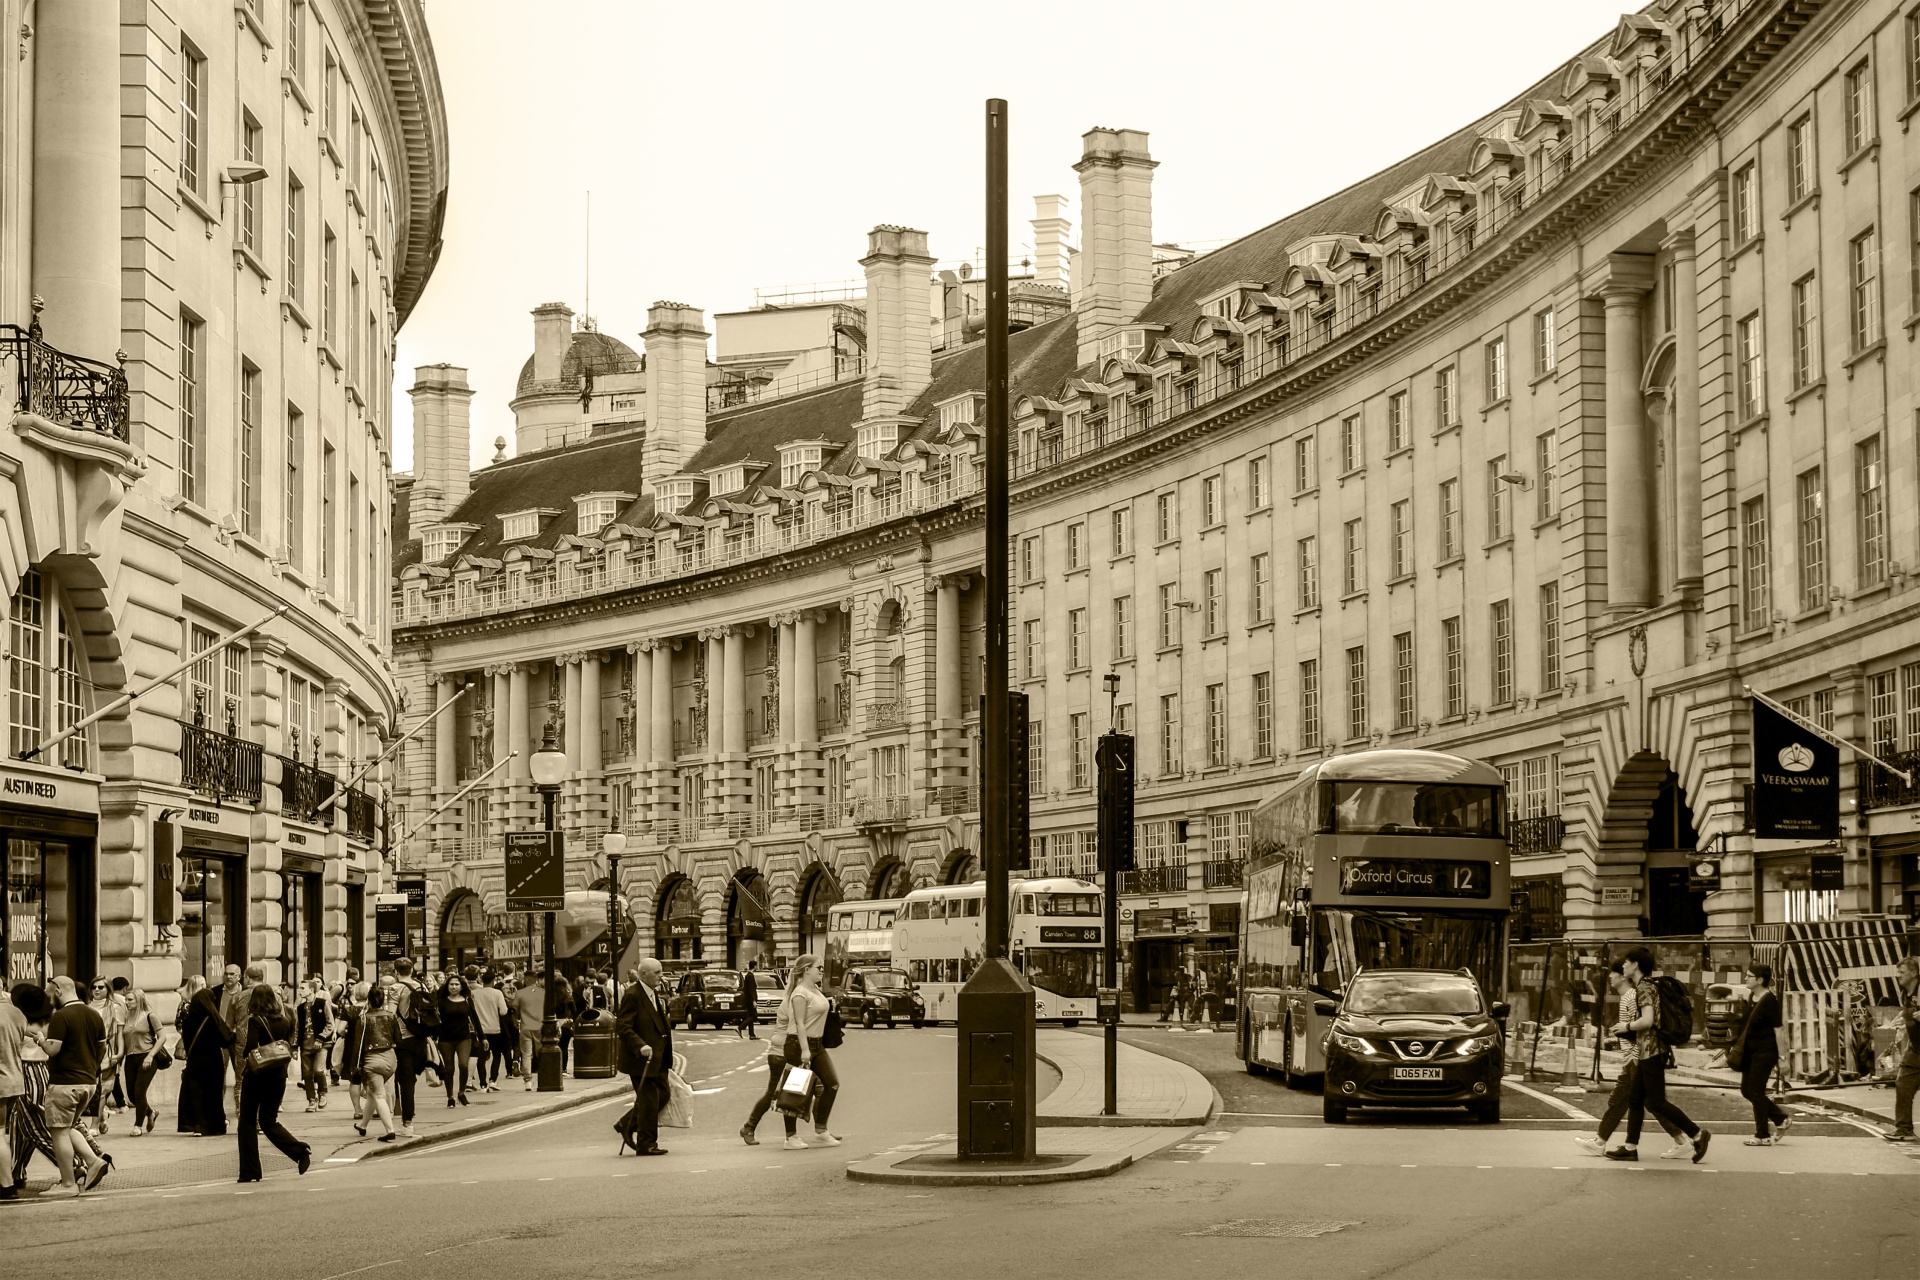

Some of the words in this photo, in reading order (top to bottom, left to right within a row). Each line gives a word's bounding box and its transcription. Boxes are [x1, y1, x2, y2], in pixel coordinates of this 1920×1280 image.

[1761, 774, 1830, 786] VEERASWAMY
[3, 777, 34, 795] AUSTIN
[35, 782, 57, 799] REED
[188, 808, 206, 822] AUSTIN
[207, 811, 220, 825] REED
[1350, 867, 1392, 883] Oxford
[1396, 869, 1433, 884] Circus
[1453, 867, 1473, 889] 12
[11, 915, 37, 942] MASSIVE
[671, 925, 690, 934] Barbour
[1083, 929, 1096, 940] 88
[598, 943, 608, 954] 12
[11, 952, 37, 980] STOCK
[1395, 1069, 1420, 1078] LO65
